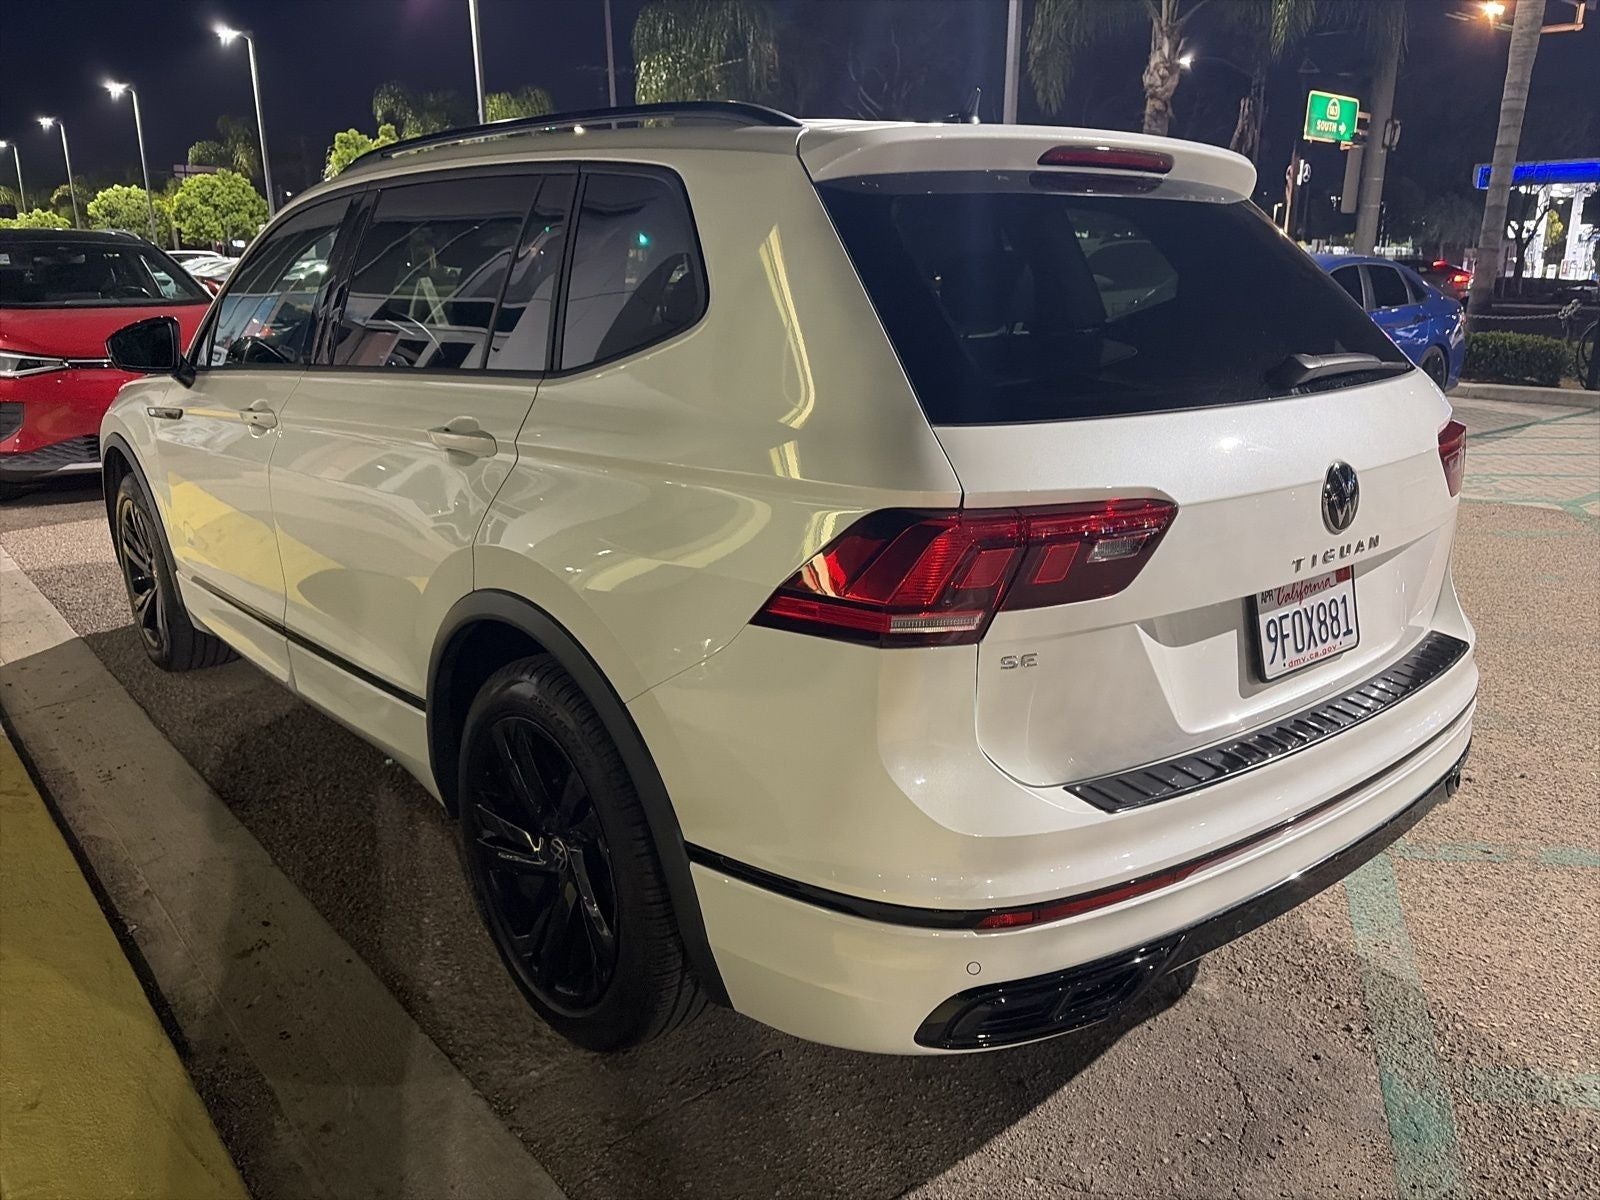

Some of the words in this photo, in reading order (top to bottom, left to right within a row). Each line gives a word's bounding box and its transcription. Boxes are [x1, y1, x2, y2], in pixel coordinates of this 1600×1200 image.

[1316, 119, 1338, 132] SOUTH
[1291, 535, 1380, 574] TIGUAN
[1260, 589, 1274, 604] APR
[1276, 576, 1337, 606] California
[1000, 652, 1038, 670] SE
[1287, 644, 1338, 668] dmv.ca.gov
